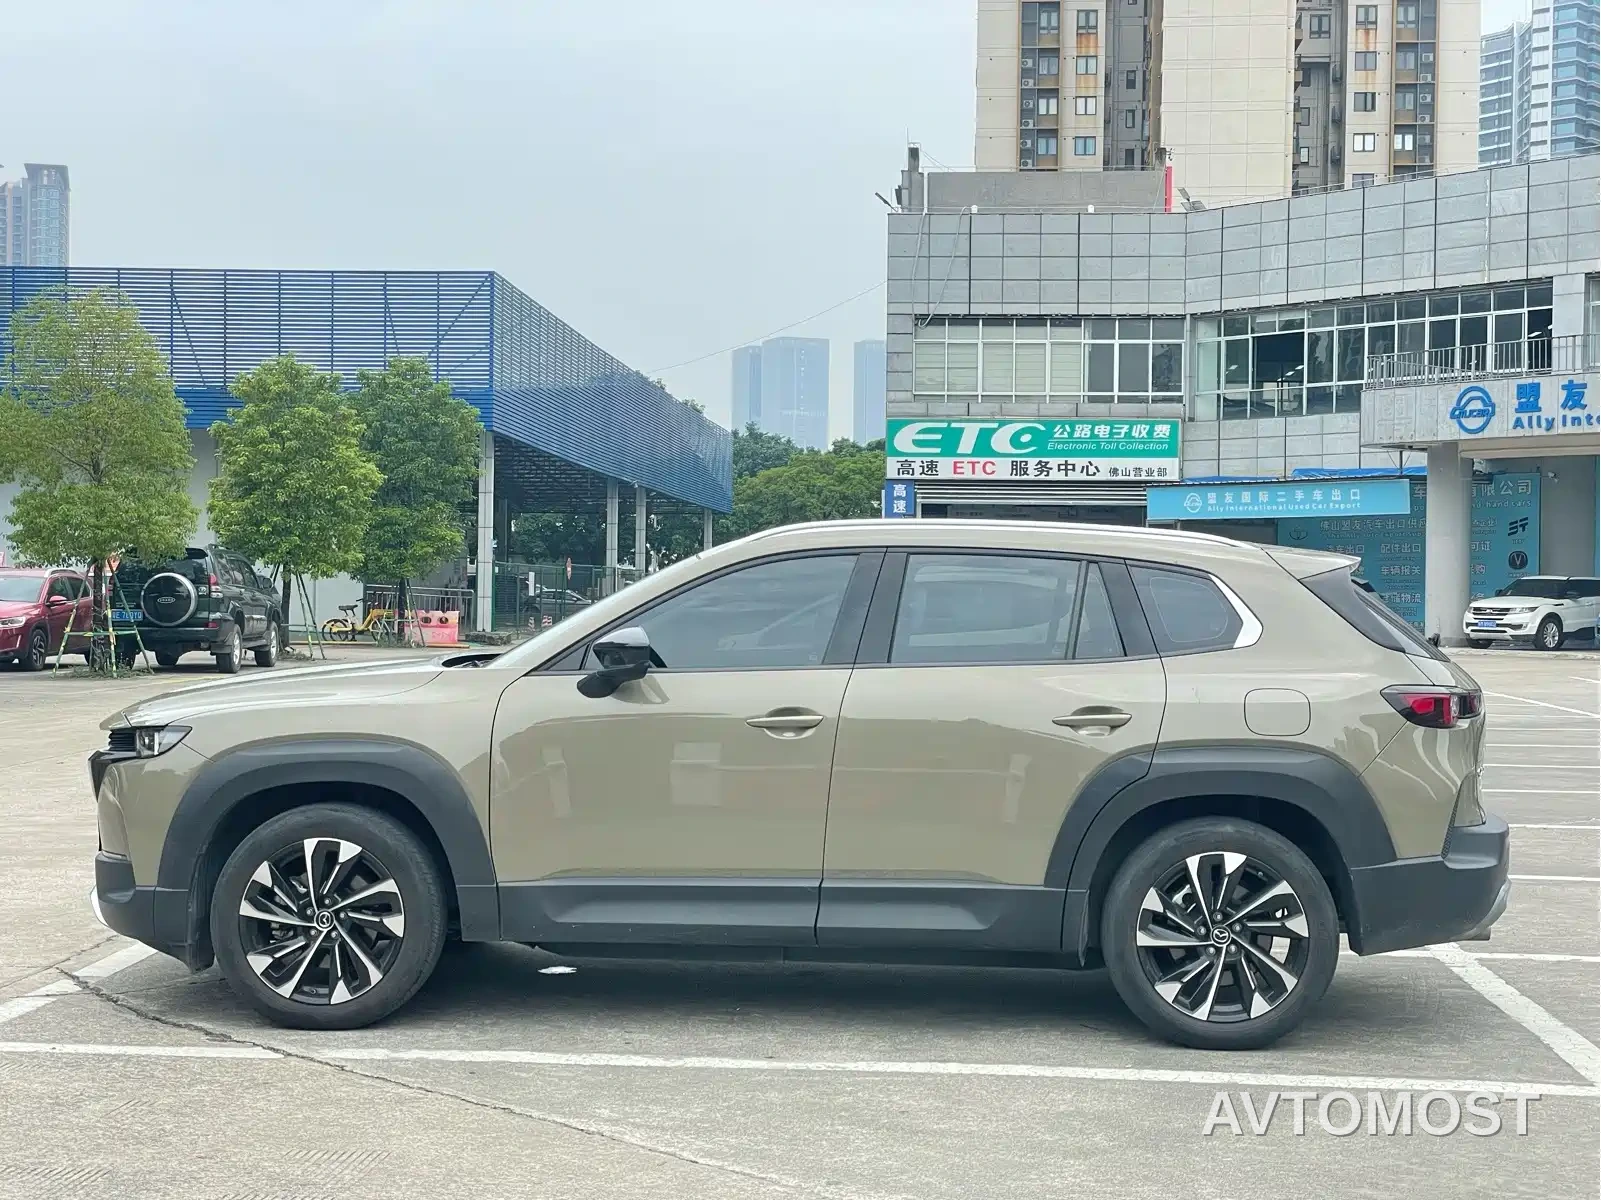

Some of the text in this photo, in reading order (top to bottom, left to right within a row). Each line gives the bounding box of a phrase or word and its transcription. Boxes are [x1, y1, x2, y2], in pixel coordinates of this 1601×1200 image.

[1514, 379, 1588, 413] 盟友
[1053, 423, 1172, 439] 公路电子收费
[1512, 414, 1554, 432] Ally
[893, 422, 1046, 454] ETC
[1047, 441, 1169, 451] Electronic Toll Collection
[896, 459, 1168, 478] 高速 ETC 服务中心 佛山营业部
[892, 483, 907, 514] 高速
[1207, 488, 1361, 504] 盟友国际二手车出口
[1207, 500, 1361, 513] Ally International Used Car Export
[1380, 543, 1421, 553] 配件出口
[1380, 564, 1421, 576] 车辆报关
